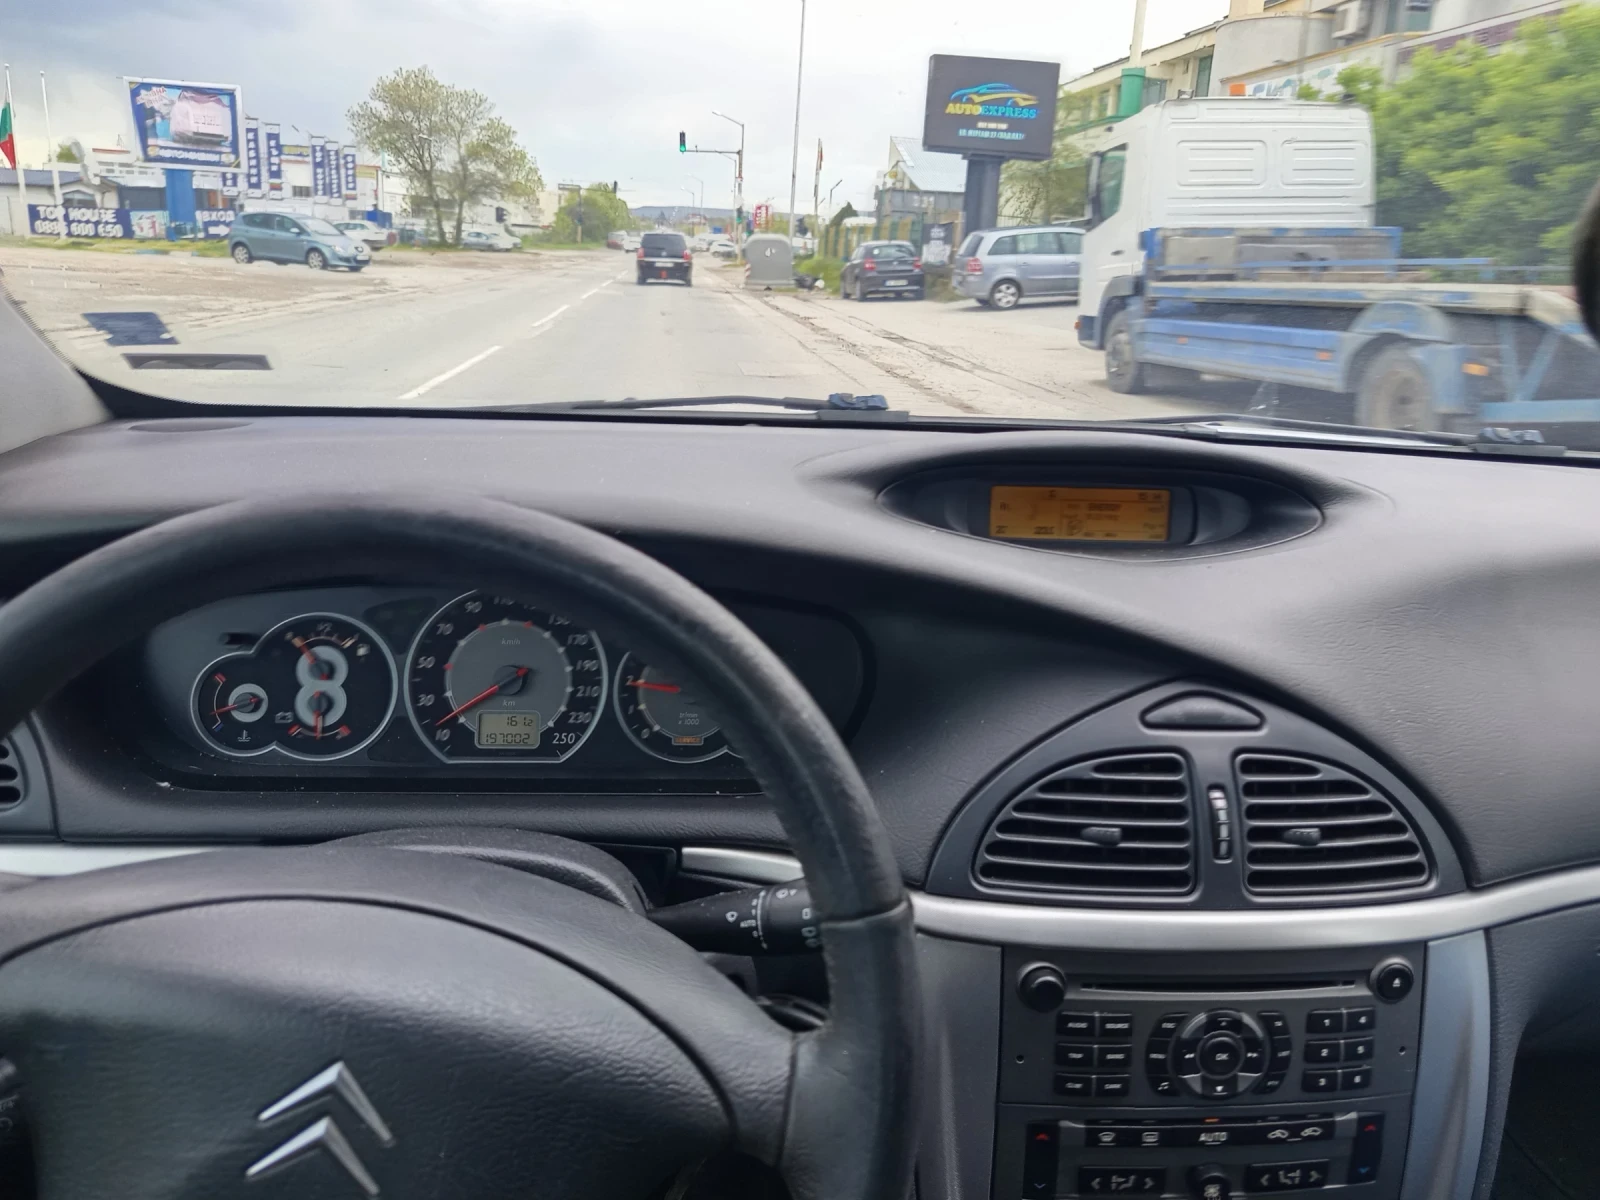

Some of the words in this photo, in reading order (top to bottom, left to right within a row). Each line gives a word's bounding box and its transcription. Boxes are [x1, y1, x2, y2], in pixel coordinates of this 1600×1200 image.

[945, 103, 1037, 118] AUTOEXPRESS
[464, 600, 483, 613] 90
[436, 623, 453, 636] 70
[566, 634, 589, 646] 170
[418, 656, 435, 668] 50
[575, 660, 599, 671] 190
[576, 686, 600, 697] 210
[418, 694, 435, 706] 30
[503, 699, 516, 707] km
[568, 712, 592, 724] 230
[436, 729, 451, 741] 10
[485, 733, 531, 744] 197002
[552, 733, 576, 745] 250
[1320, 1048, 1328, 1056] 2
[1356, 1045, 1365, 1054] 5
[1319, 1078, 1326, 1086] 3
[1353, 1075, 1361, 1083] 6
[1198, 1131, 1228, 1141] AUTO
